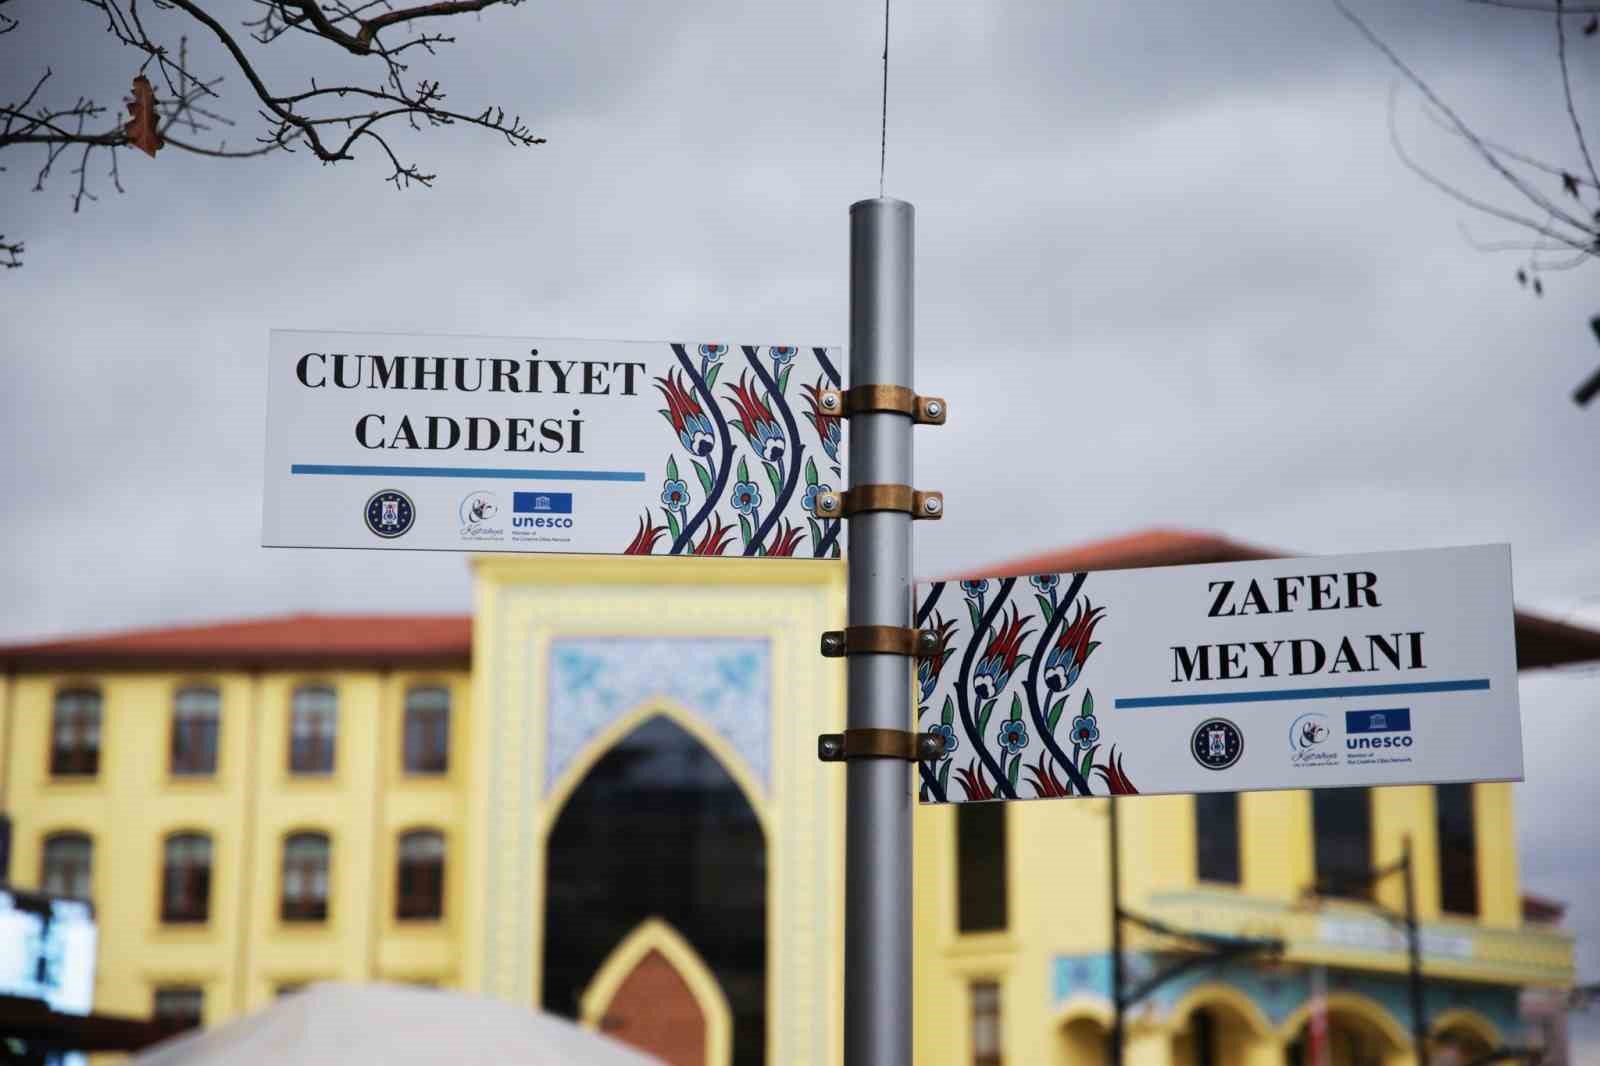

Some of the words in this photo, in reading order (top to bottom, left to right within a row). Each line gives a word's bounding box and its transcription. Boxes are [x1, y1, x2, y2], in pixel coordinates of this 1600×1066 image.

[297, 350, 645, 396] CUMHURİYET
[356, 409, 583, 454] CADDESİ
[512, 517, 573, 528] unesco
[1208, 572, 1381, 618] ZAFER
[1171, 632, 1427, 683] MEYDANI
[1346, 736, 1413, 749] unesco
